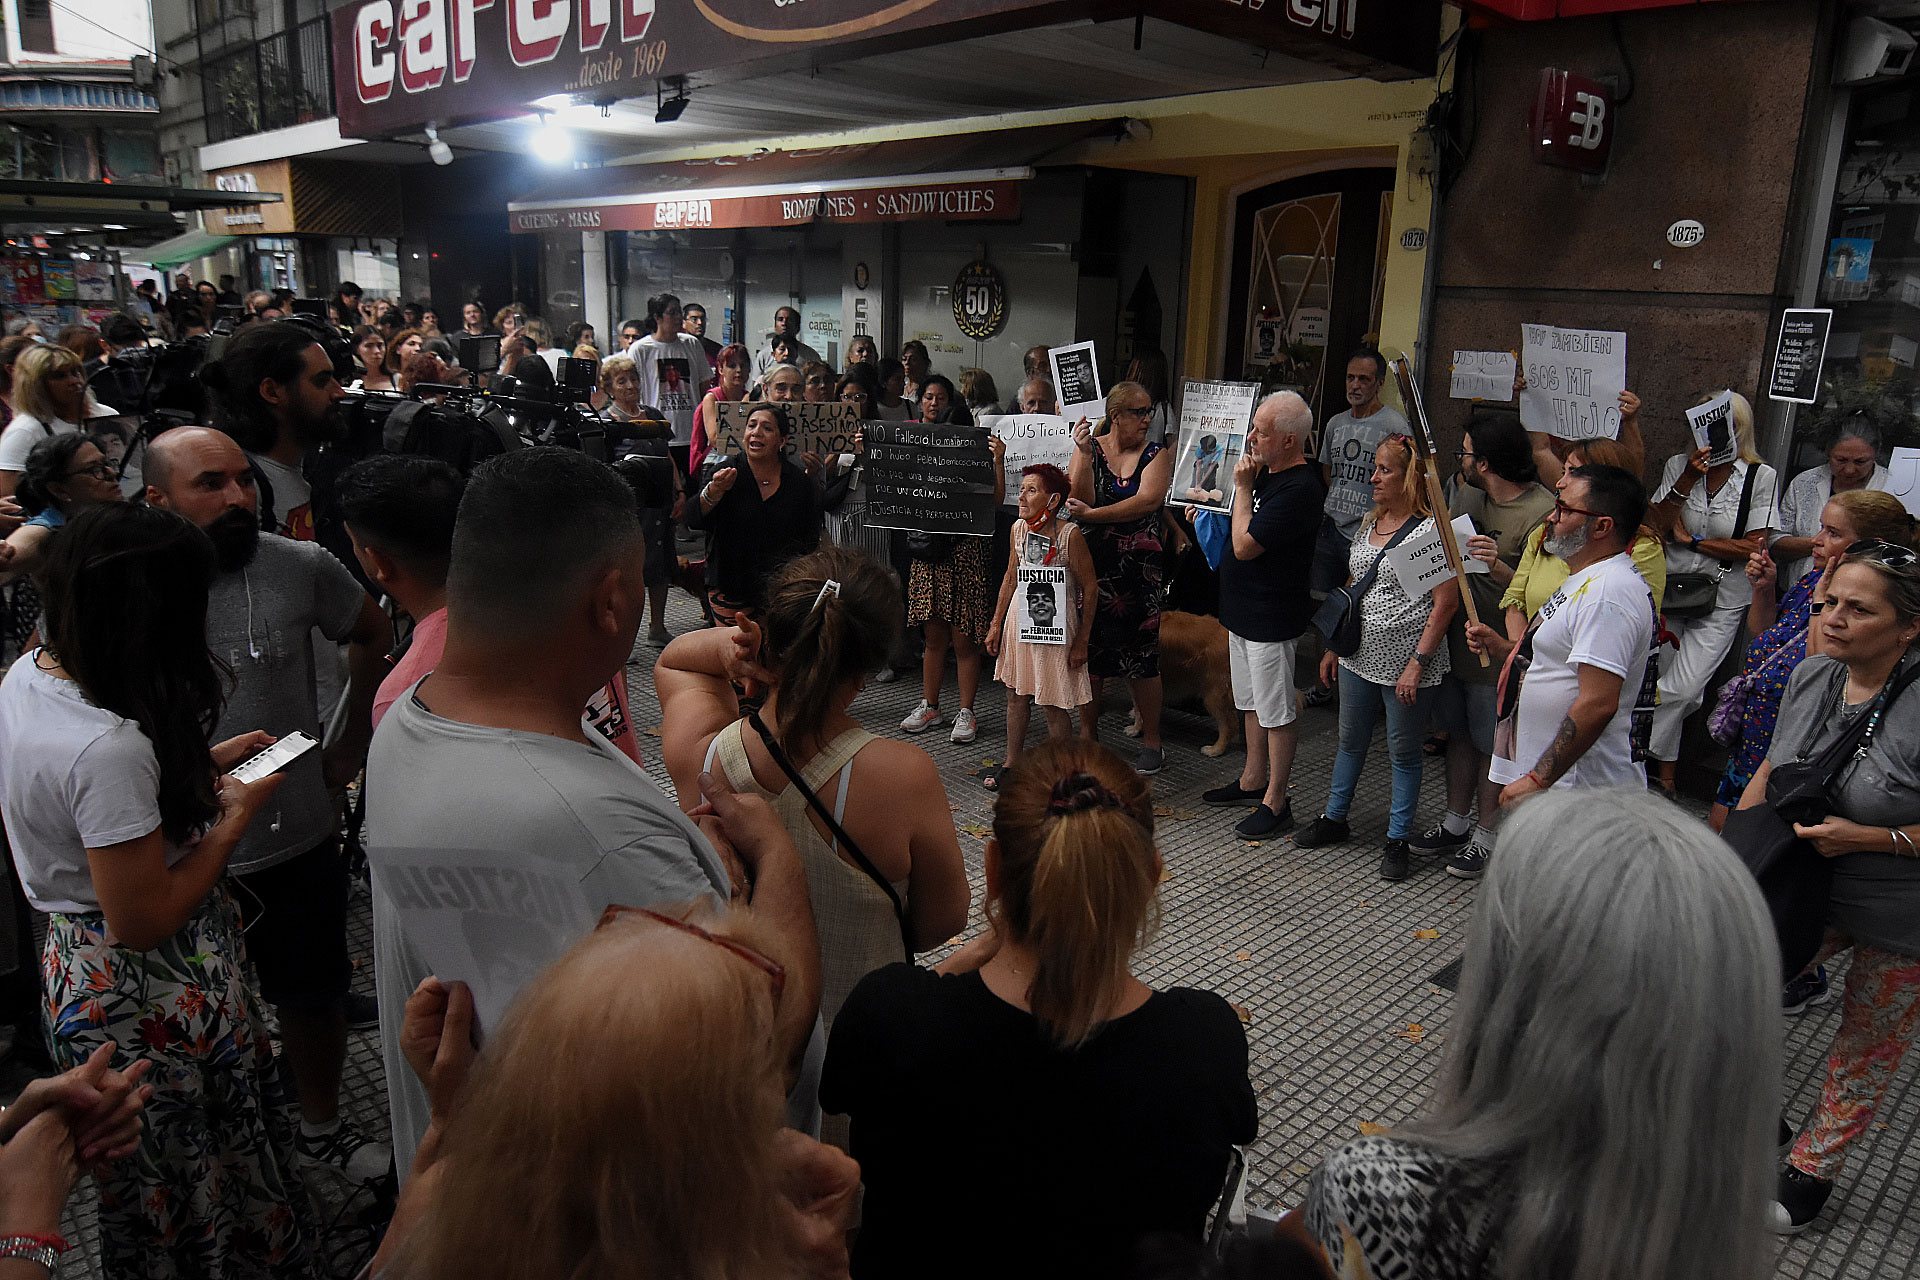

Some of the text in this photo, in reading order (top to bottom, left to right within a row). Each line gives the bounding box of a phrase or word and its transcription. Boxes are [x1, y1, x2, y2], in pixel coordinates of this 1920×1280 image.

[630, 40, 668, 78] 1969
[781, 189, 995, 220] BOMBONES SANDWICHES
[568, 211, 601, 228] MASAS
[655, 200, 712, 228] caren
[1402, 232, 1425, 247] 1879
[1671, 226, 1699, 242] 1875
[965, 286, 990, 315] 50
[808, 320, 834, 331] caren
[1528, 363, 1560, 391] SOS
[1693, 400, 1731, 430] JUSTICIA
[1362, 450, 1377, 465] TH
[912, 488, 949, 500] CRIMEN
[1408, 540, 1443, 562] JUSTIC
[1430, 553, 1445, 564] ES
[1018, 569, 1066, 584] JUSTICIA
[1030, 626, 1065, 636] FERNANDO
